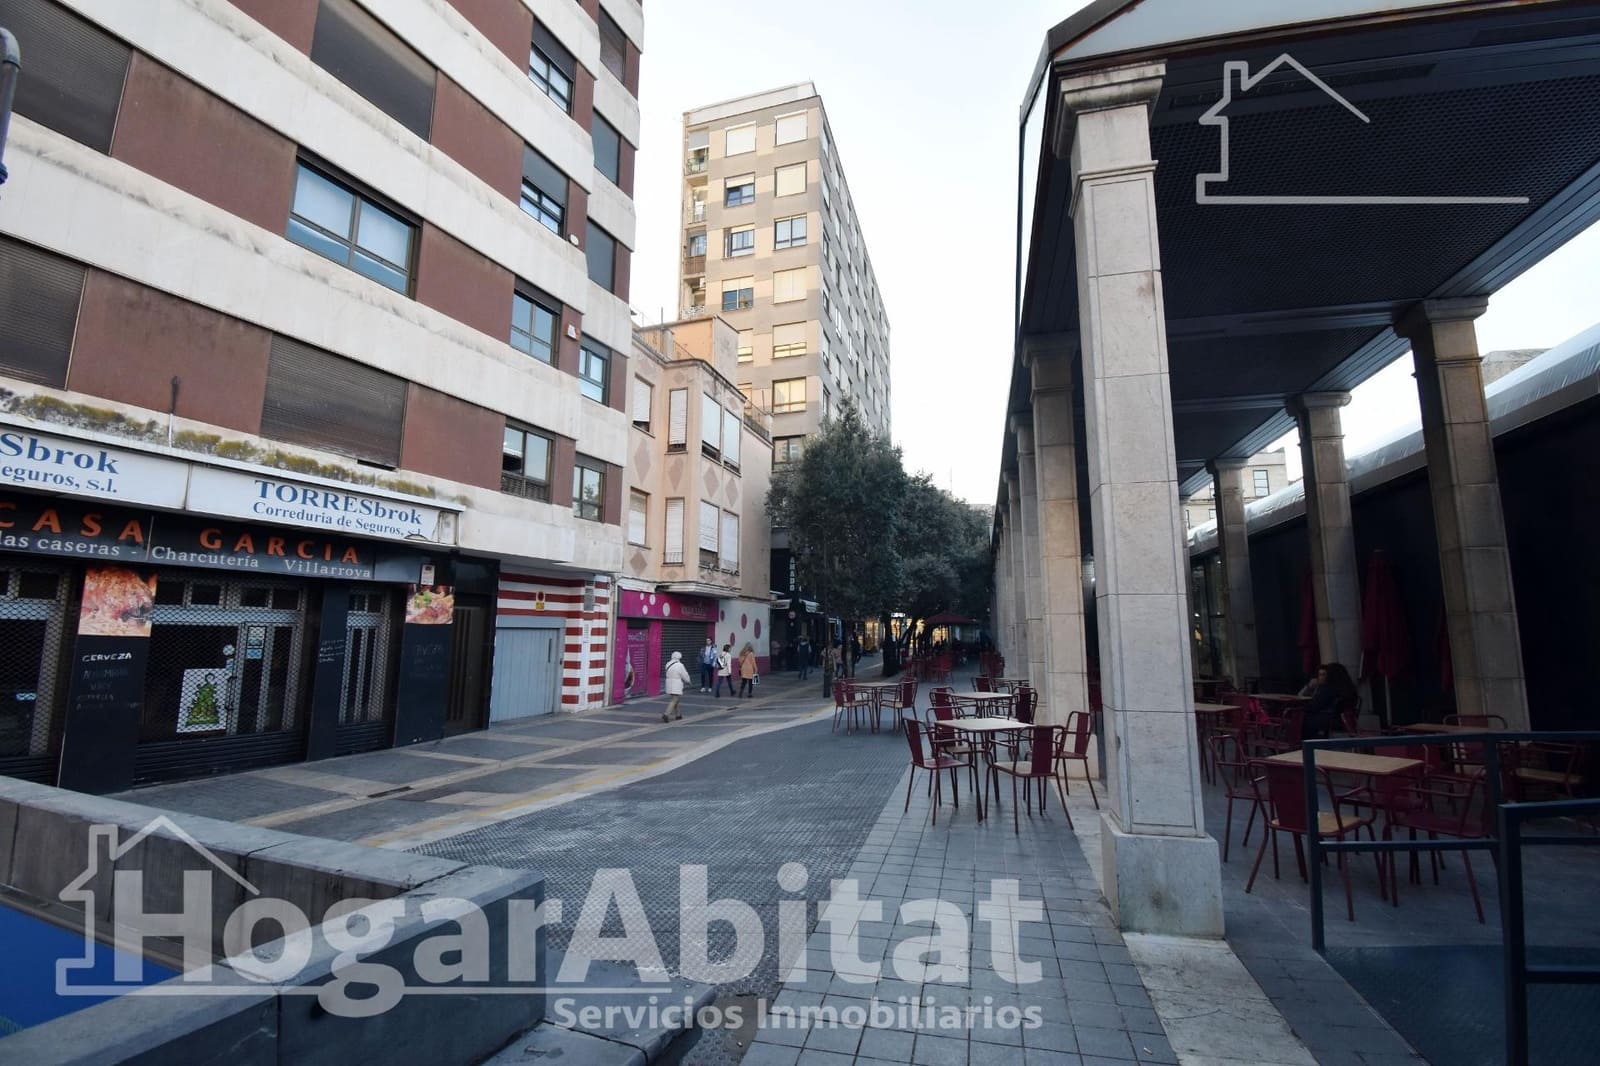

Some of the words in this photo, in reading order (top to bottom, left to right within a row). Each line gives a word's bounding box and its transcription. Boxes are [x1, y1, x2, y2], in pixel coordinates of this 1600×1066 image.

[0, 433, 119, 475] Sbrok
[255, 479, 422, 525] TORRESbrok
[337, 515, 352, 527] de
[37, 537, 120, 556] caseras
[152, 546, 259, 568] Charcutería
[200, 528, 359, 564] GARCIA
[82, 652, 132, 662] CERVEZA
